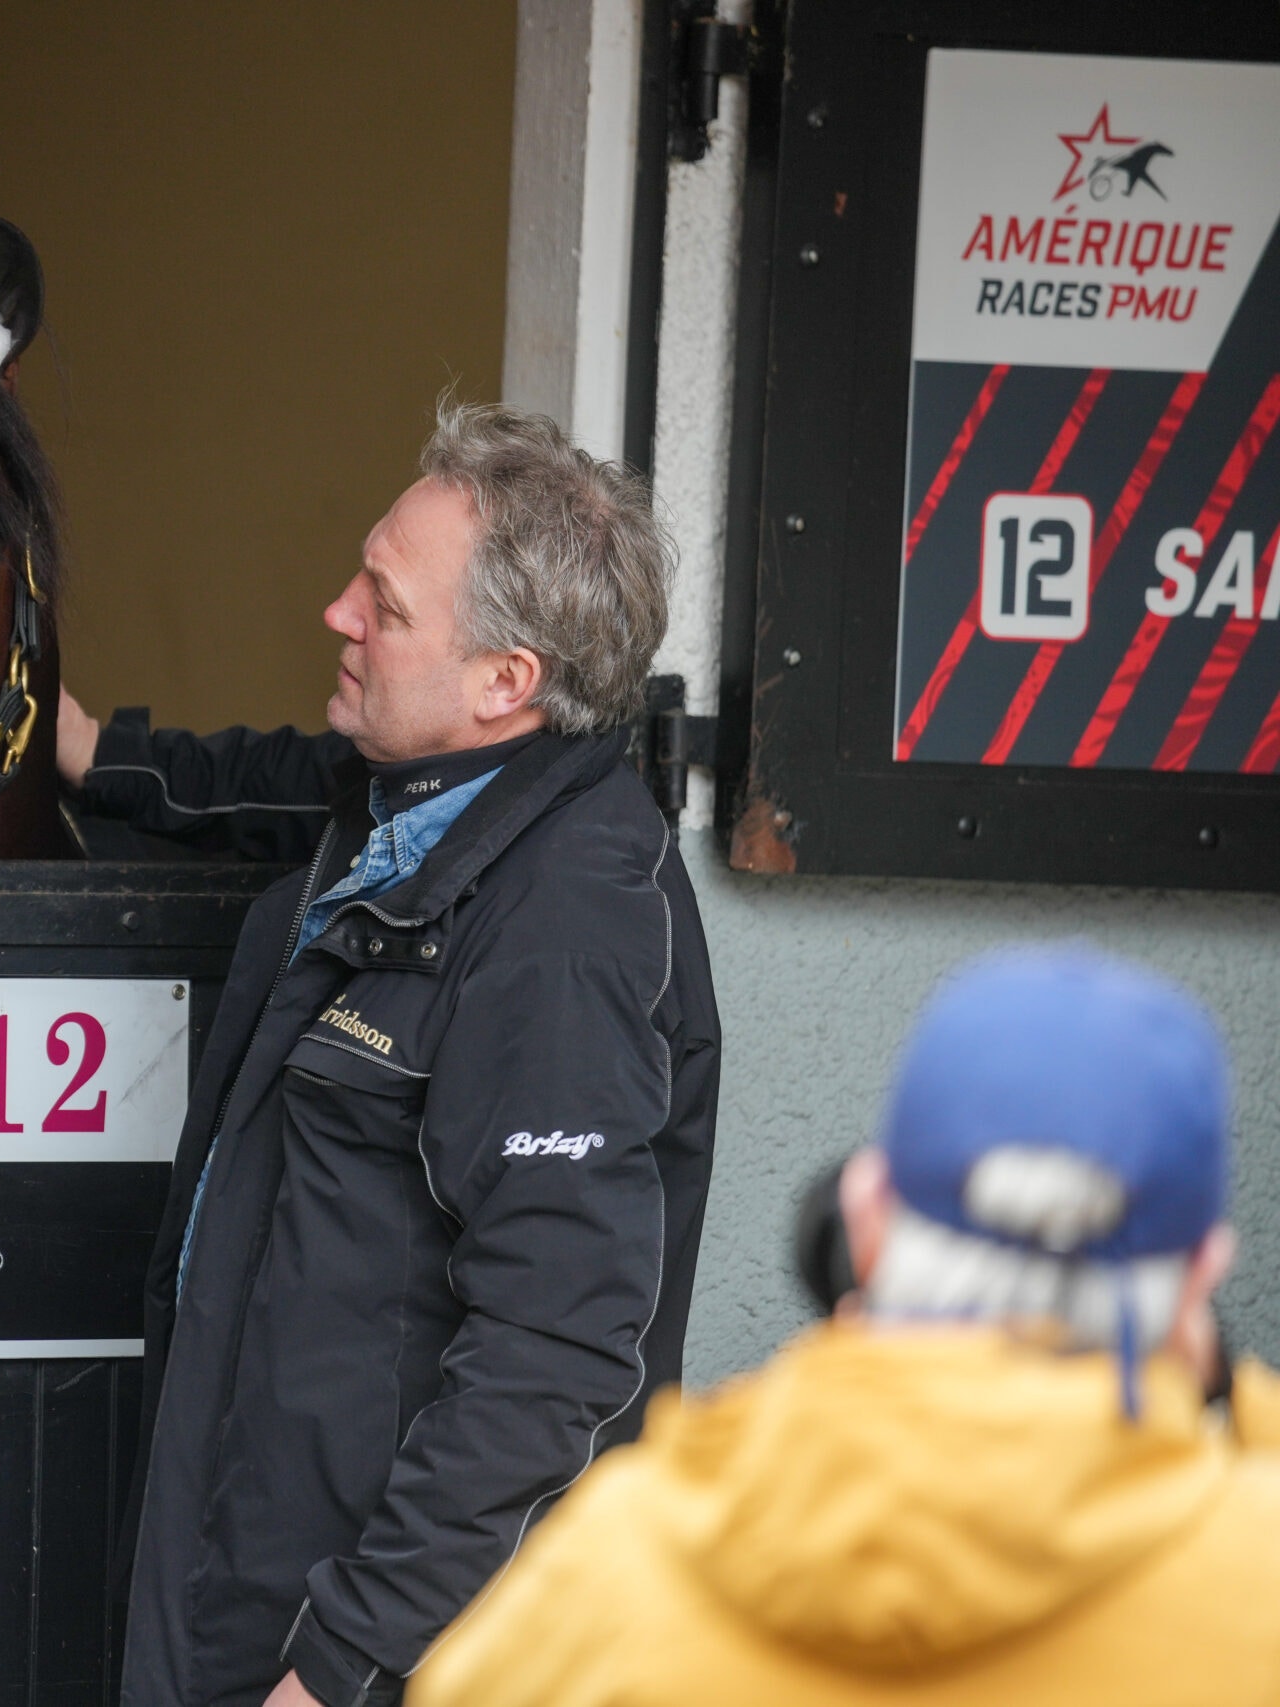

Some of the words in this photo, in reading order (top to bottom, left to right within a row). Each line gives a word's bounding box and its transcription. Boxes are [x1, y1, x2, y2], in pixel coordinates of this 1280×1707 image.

[962, 204, 1234, 276] AMÉRIQUE
[976, 278, 1102, 319] RACES
[1106, 283, 1198, 323] PMU
[999, 516, 1075, 618] 12
[1145, 526, 1280, 620] SA
[404, 779, 441, 794] PEAK
[318, 1004, 394, 1055] rvidsson
